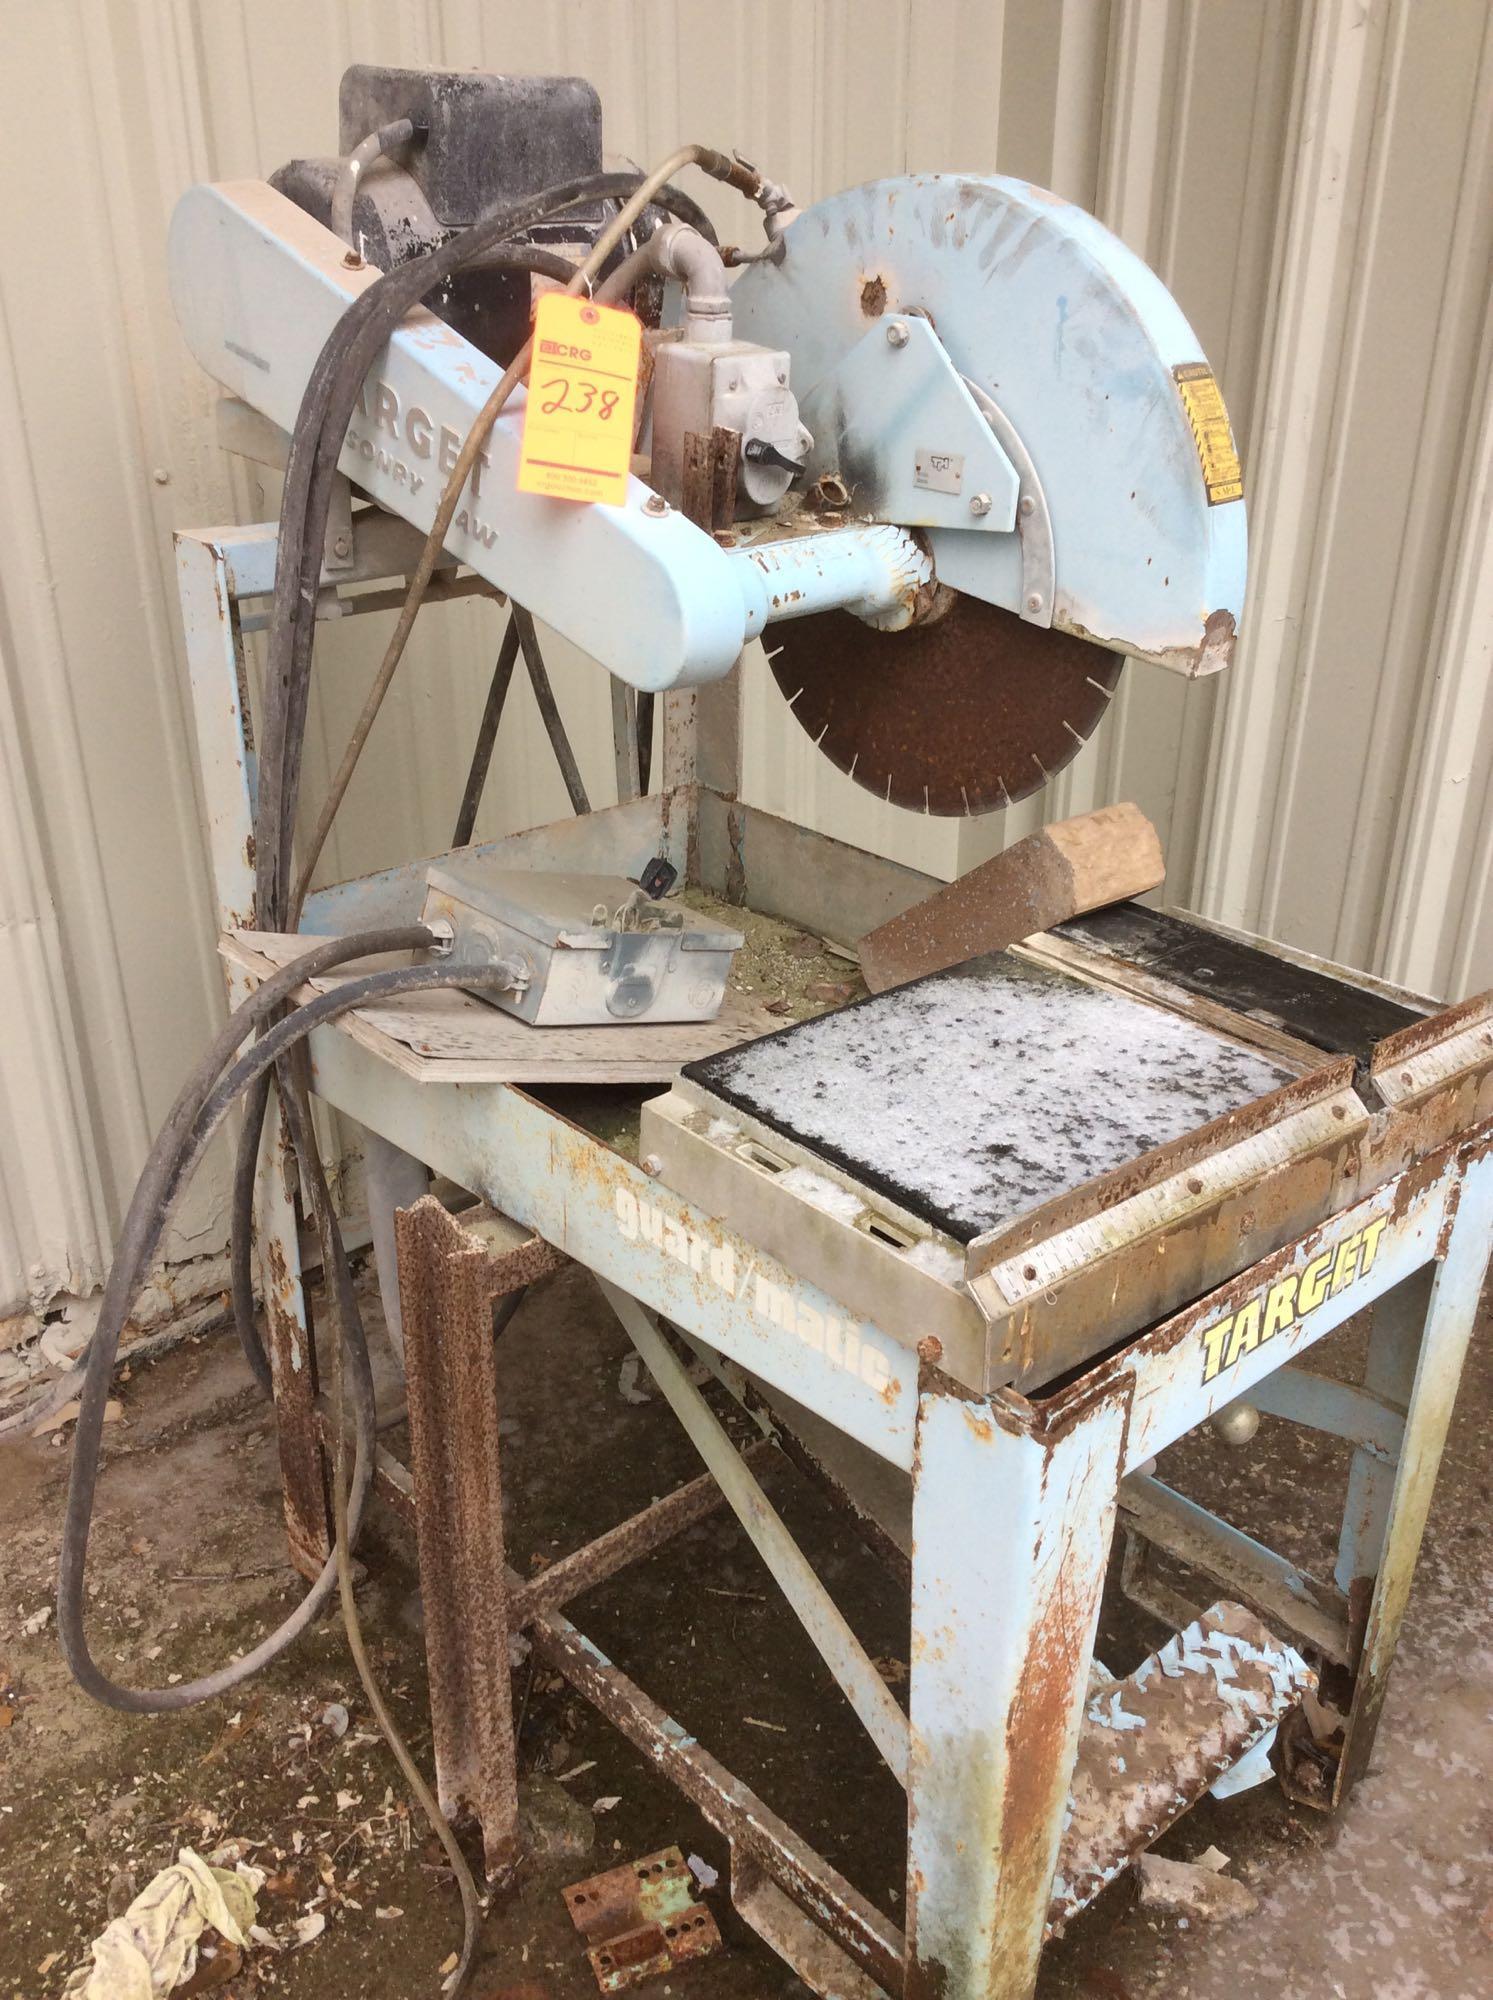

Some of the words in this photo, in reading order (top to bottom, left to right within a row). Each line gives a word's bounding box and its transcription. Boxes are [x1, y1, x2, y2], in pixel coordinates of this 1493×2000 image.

[558, 344, 592, 361] CRG
[541, 379, 620, 422] 238
[1200, 1212, 1390, 1387] TARGET
